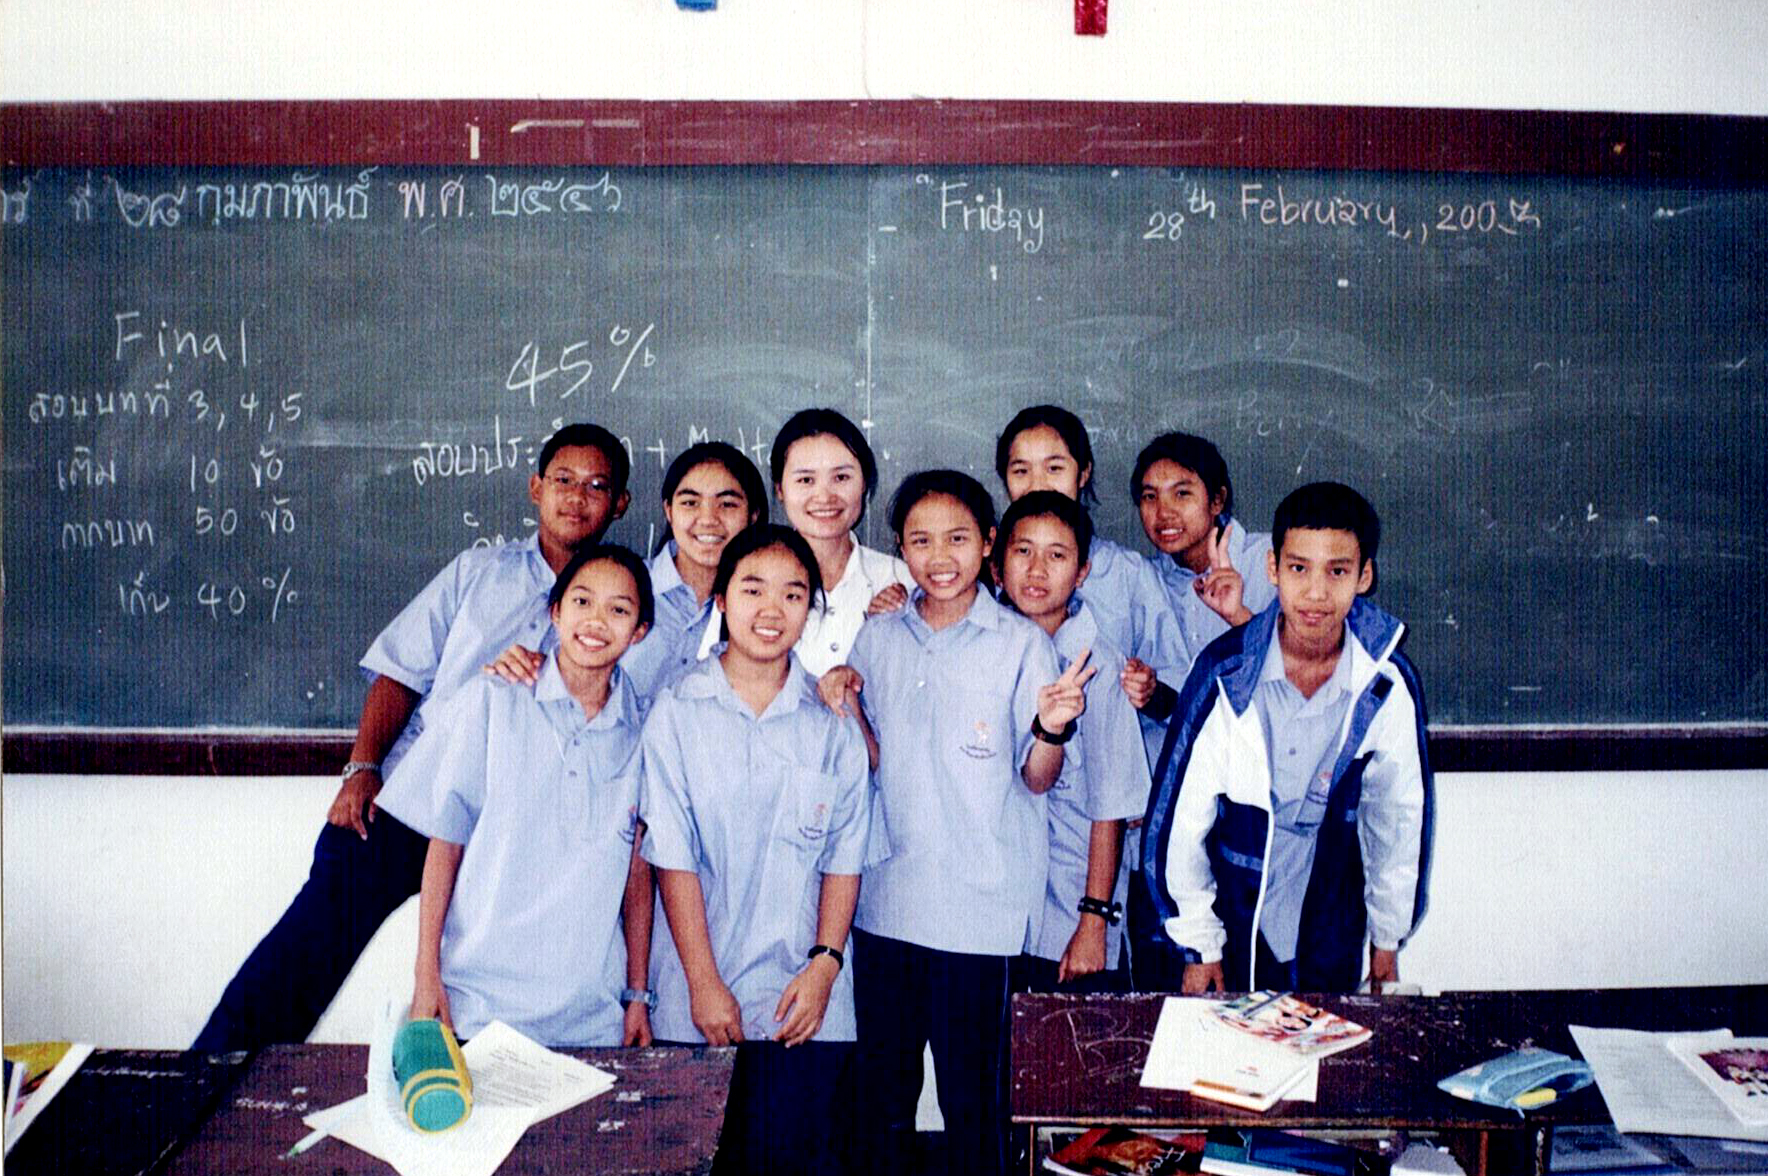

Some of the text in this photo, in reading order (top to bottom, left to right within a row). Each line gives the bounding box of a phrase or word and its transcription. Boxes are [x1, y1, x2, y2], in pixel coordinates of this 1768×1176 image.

[196, 166, 379, 226] กุมภาพันธ์
[936, 181, 1043, 253] Friday
[115, 311, 247, 367] Final
[190, 454, 219, 493] 10
[195, 507, 238, 536] 50
